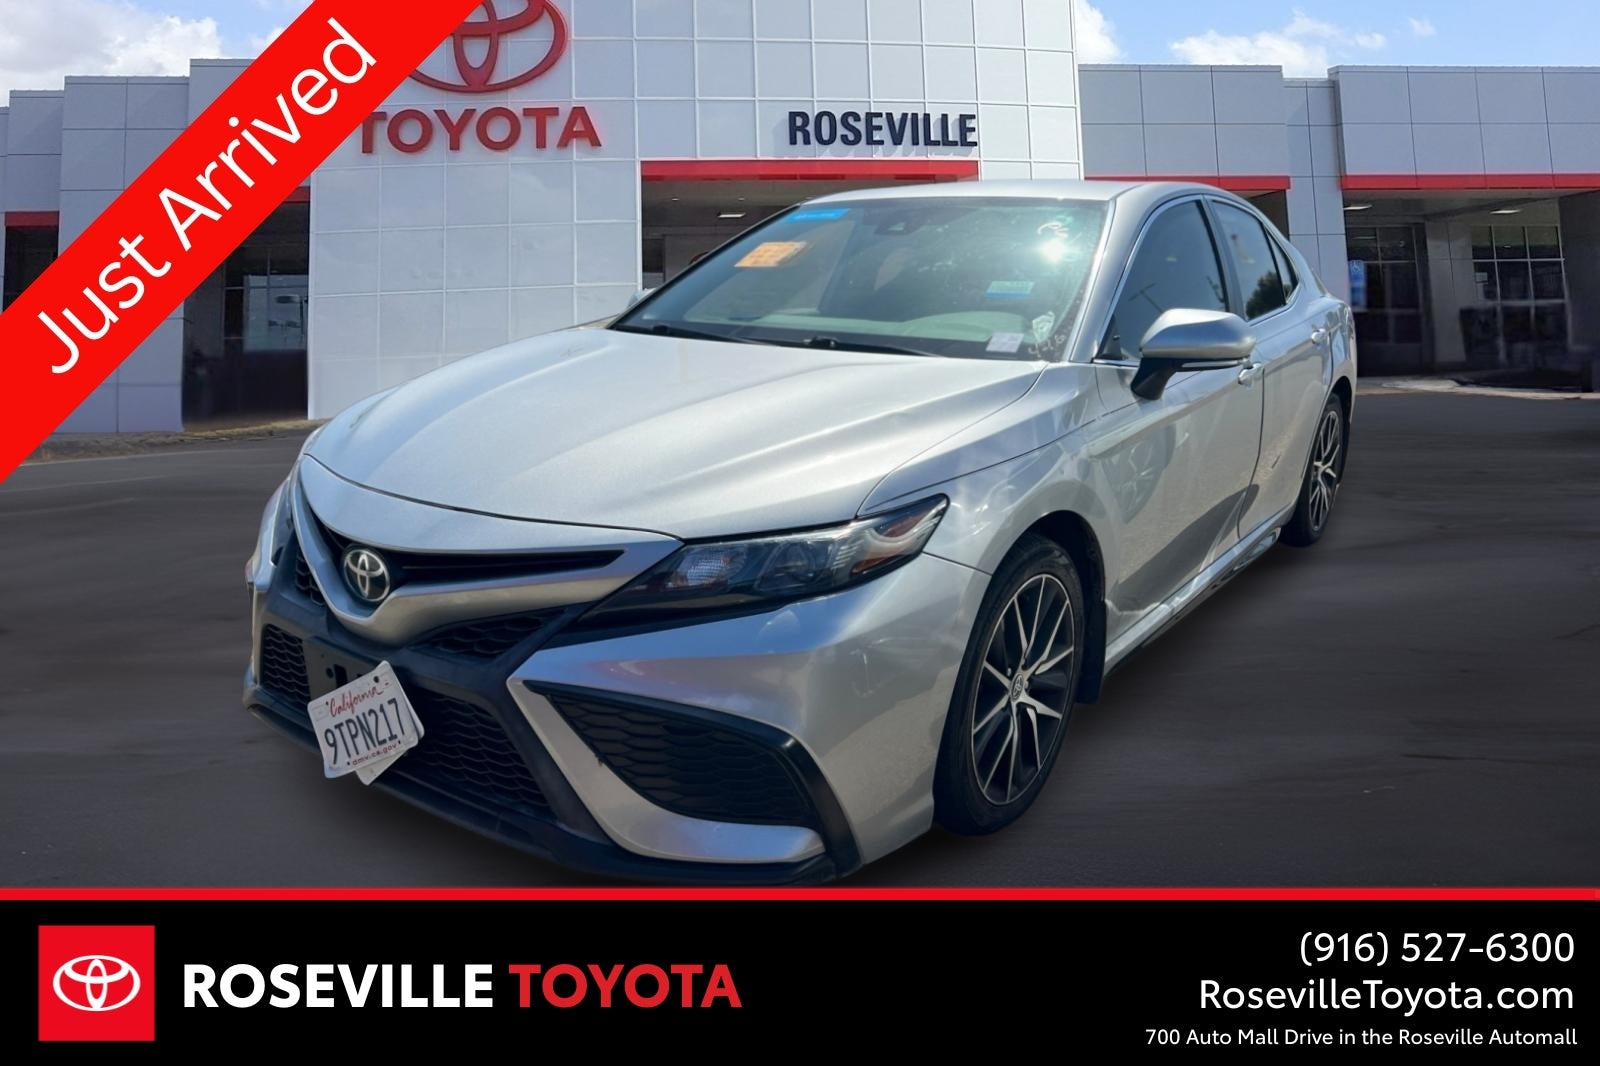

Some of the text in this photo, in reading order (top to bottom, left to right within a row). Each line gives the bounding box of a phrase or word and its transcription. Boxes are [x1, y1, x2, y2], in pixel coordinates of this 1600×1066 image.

[361, 106, 602, 154] TOYOTA
[788, 110, 978, 147] ROSEVILLE
[329, 685, 384, 718] California
[324, 697, 405, 765] 9TPN217
[352, 743, 397, 766] dmv.ca.gov
